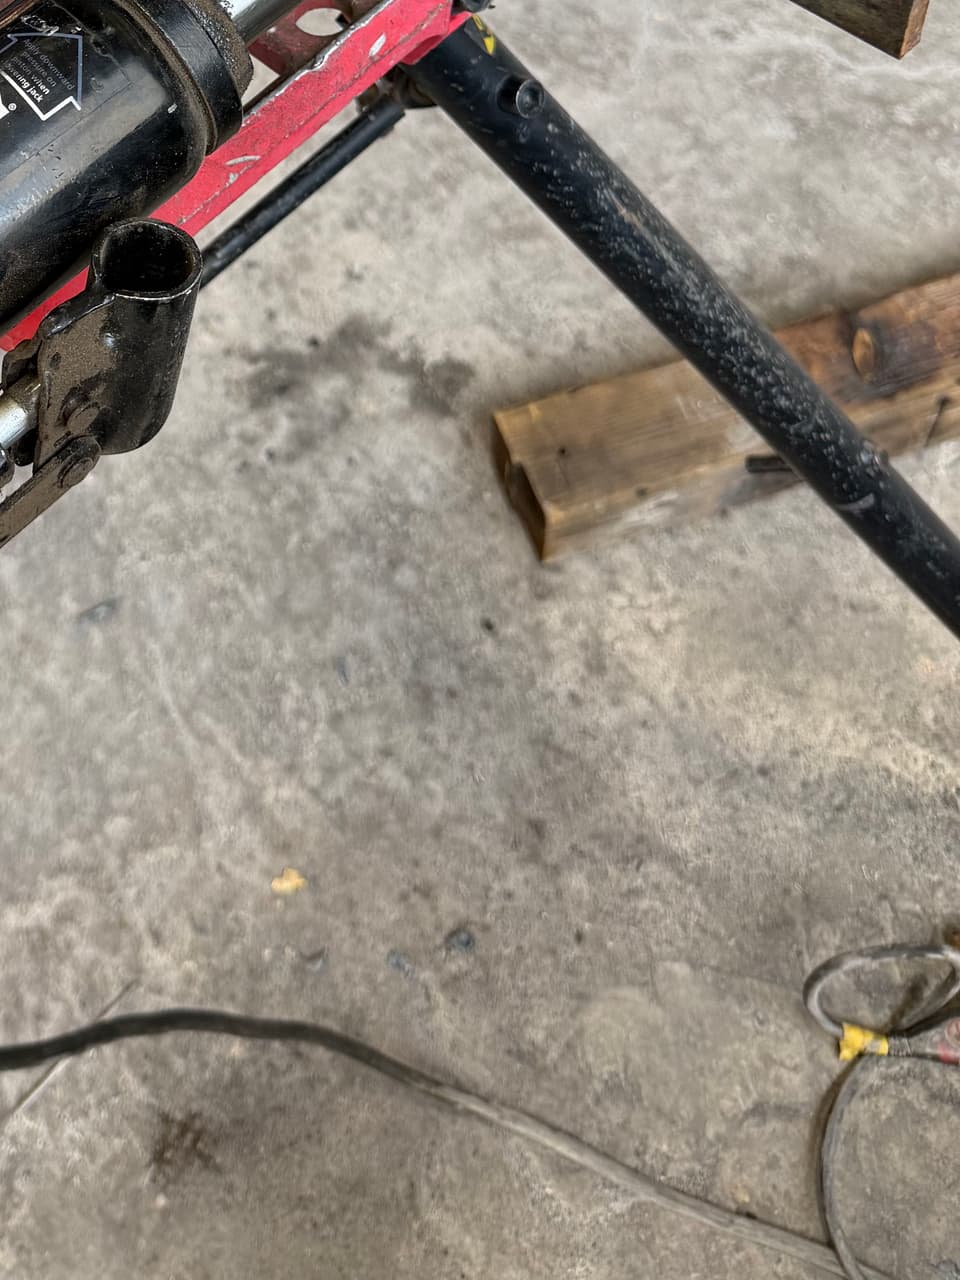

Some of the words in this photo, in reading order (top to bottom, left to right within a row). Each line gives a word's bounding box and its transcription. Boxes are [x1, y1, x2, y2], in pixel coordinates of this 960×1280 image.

[11, 57, 32, 77] piston
[31, 75, 50, 95] when
[22, 52, 48, 77] pressure
[47, 75, 57, 87] on
[23, 39, 41, 55] Apply
[40, 55, 75, 90] downward
[27, 84, 44, 103] jack
